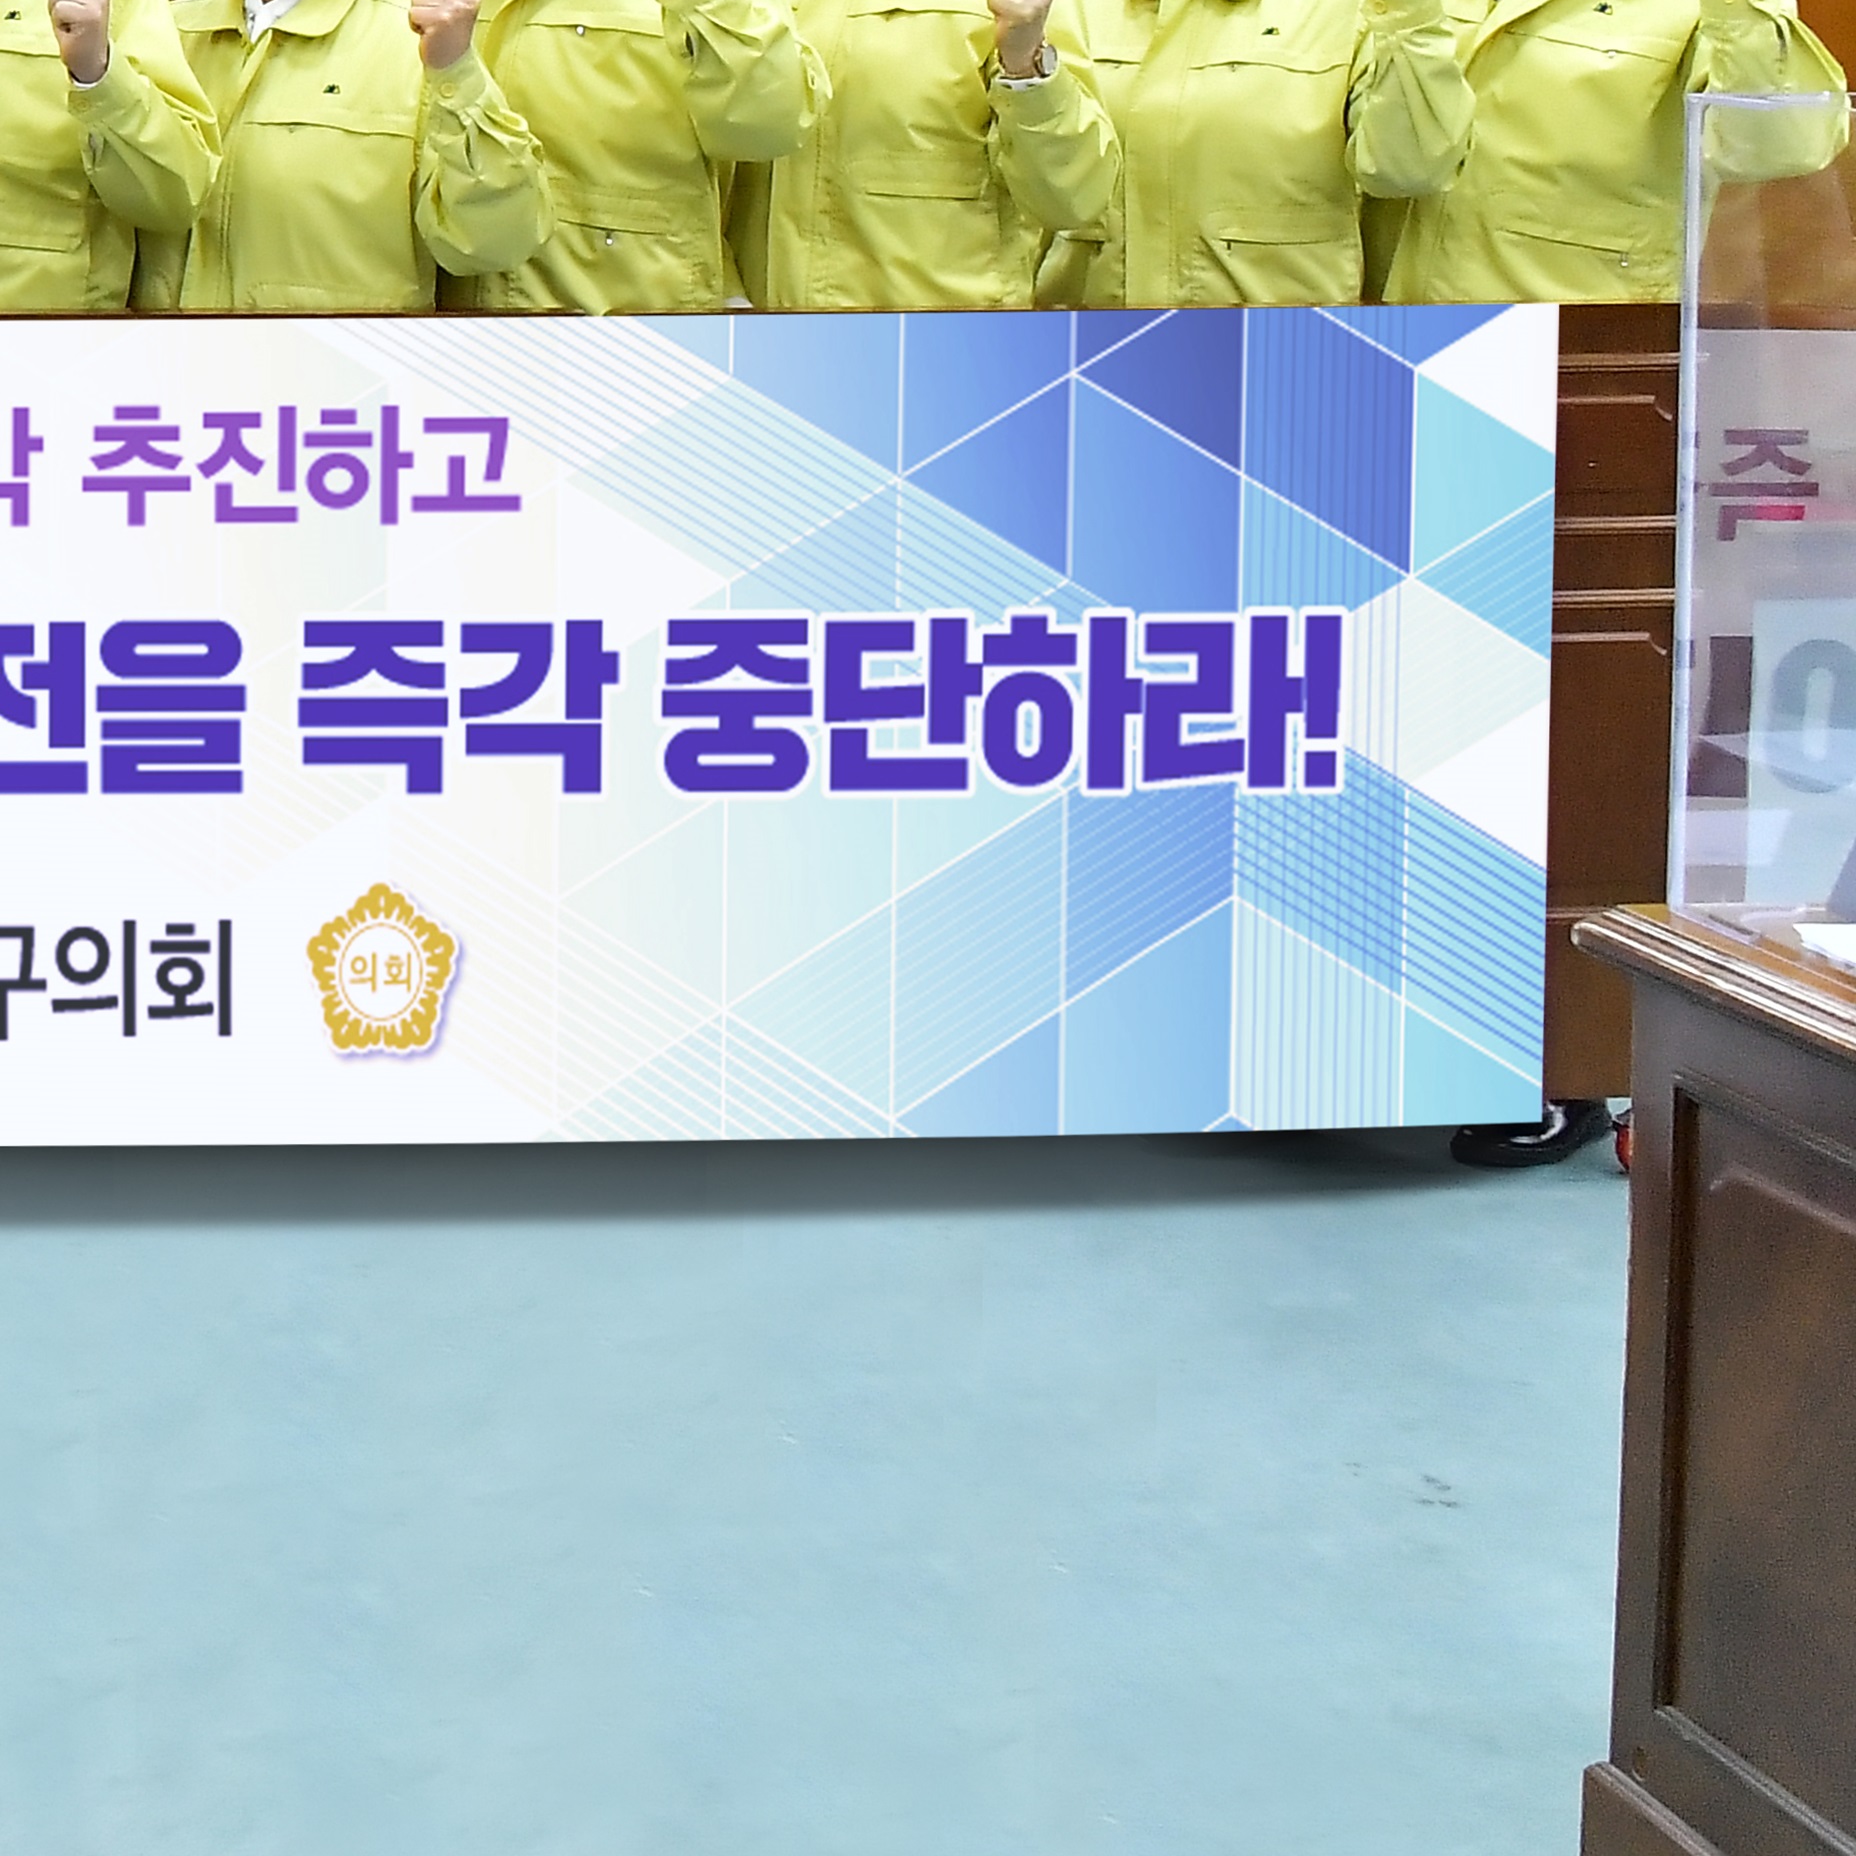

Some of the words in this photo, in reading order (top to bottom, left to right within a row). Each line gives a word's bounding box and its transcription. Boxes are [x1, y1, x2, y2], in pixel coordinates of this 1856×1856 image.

[83, 406, 521, 525] 추진하고
[298, 619, 618, 794] 즉각
[661, 615, 1342, 793] 중단하라!
[349, 951, 411, 993] 의회
